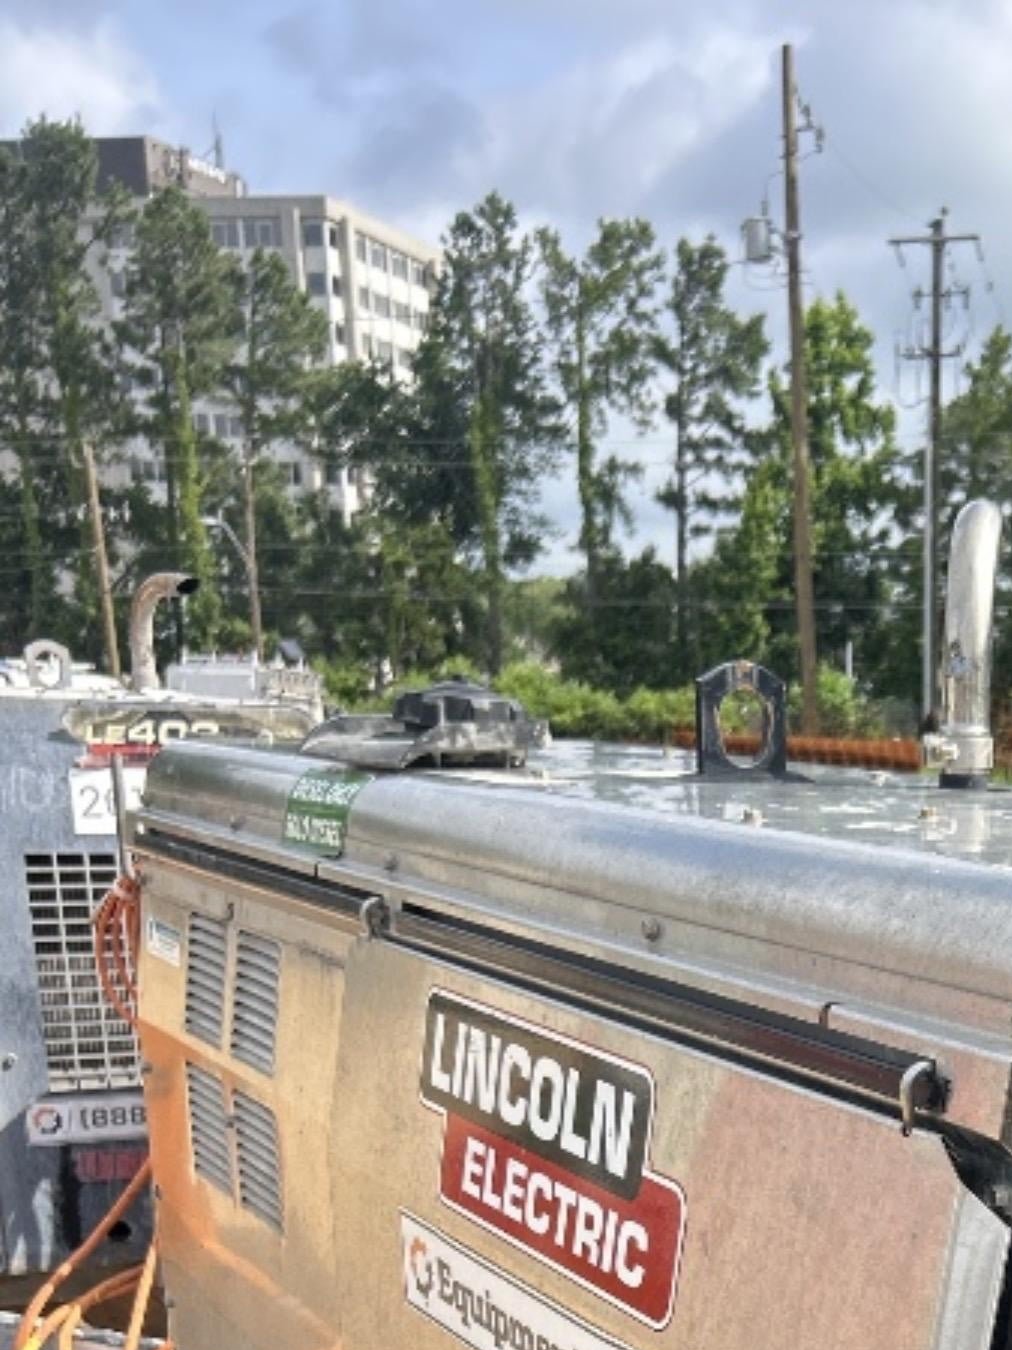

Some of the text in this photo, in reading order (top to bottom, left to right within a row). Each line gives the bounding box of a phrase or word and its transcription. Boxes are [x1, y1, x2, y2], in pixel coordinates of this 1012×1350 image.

[80, 1106, 147, 1130] (888
[430, 1013, 635, 1180] LINCOLN
[462, 1136, 647, 1288] ELECTRIC
